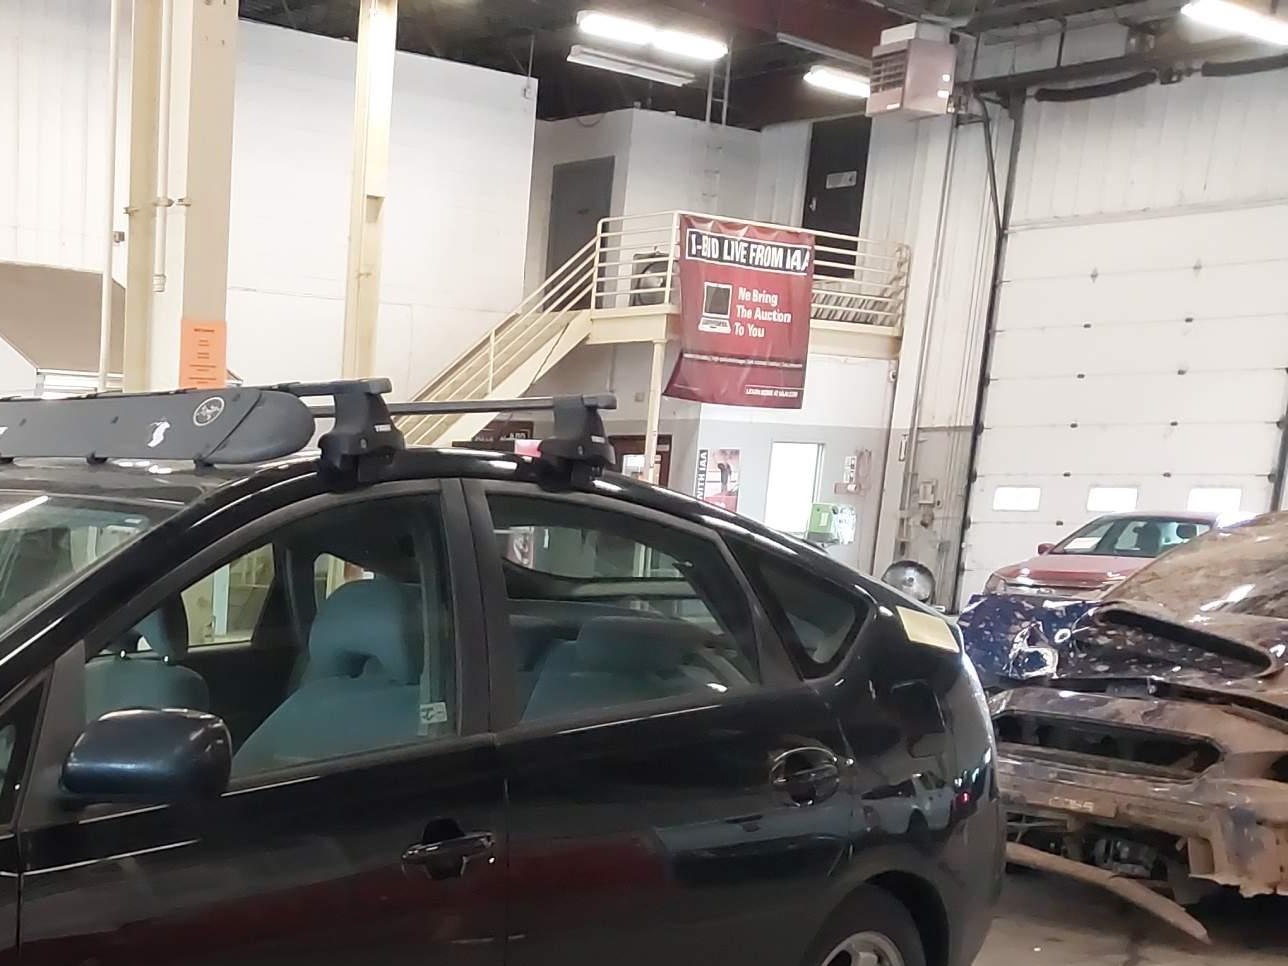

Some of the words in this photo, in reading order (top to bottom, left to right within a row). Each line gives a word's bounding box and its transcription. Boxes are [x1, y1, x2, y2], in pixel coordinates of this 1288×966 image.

[691, 233, 720, 259] I-BID
[723, 239, 749, 263] LIVE
[749, 243, 784, 268] FROM
[752, 288, 778, 307] Bring
[736, 304, 753, 320] The
[753, 306, 792, 323] Auction
[734, 321, 745, 336] To
[747, 322, 765, 338] You
